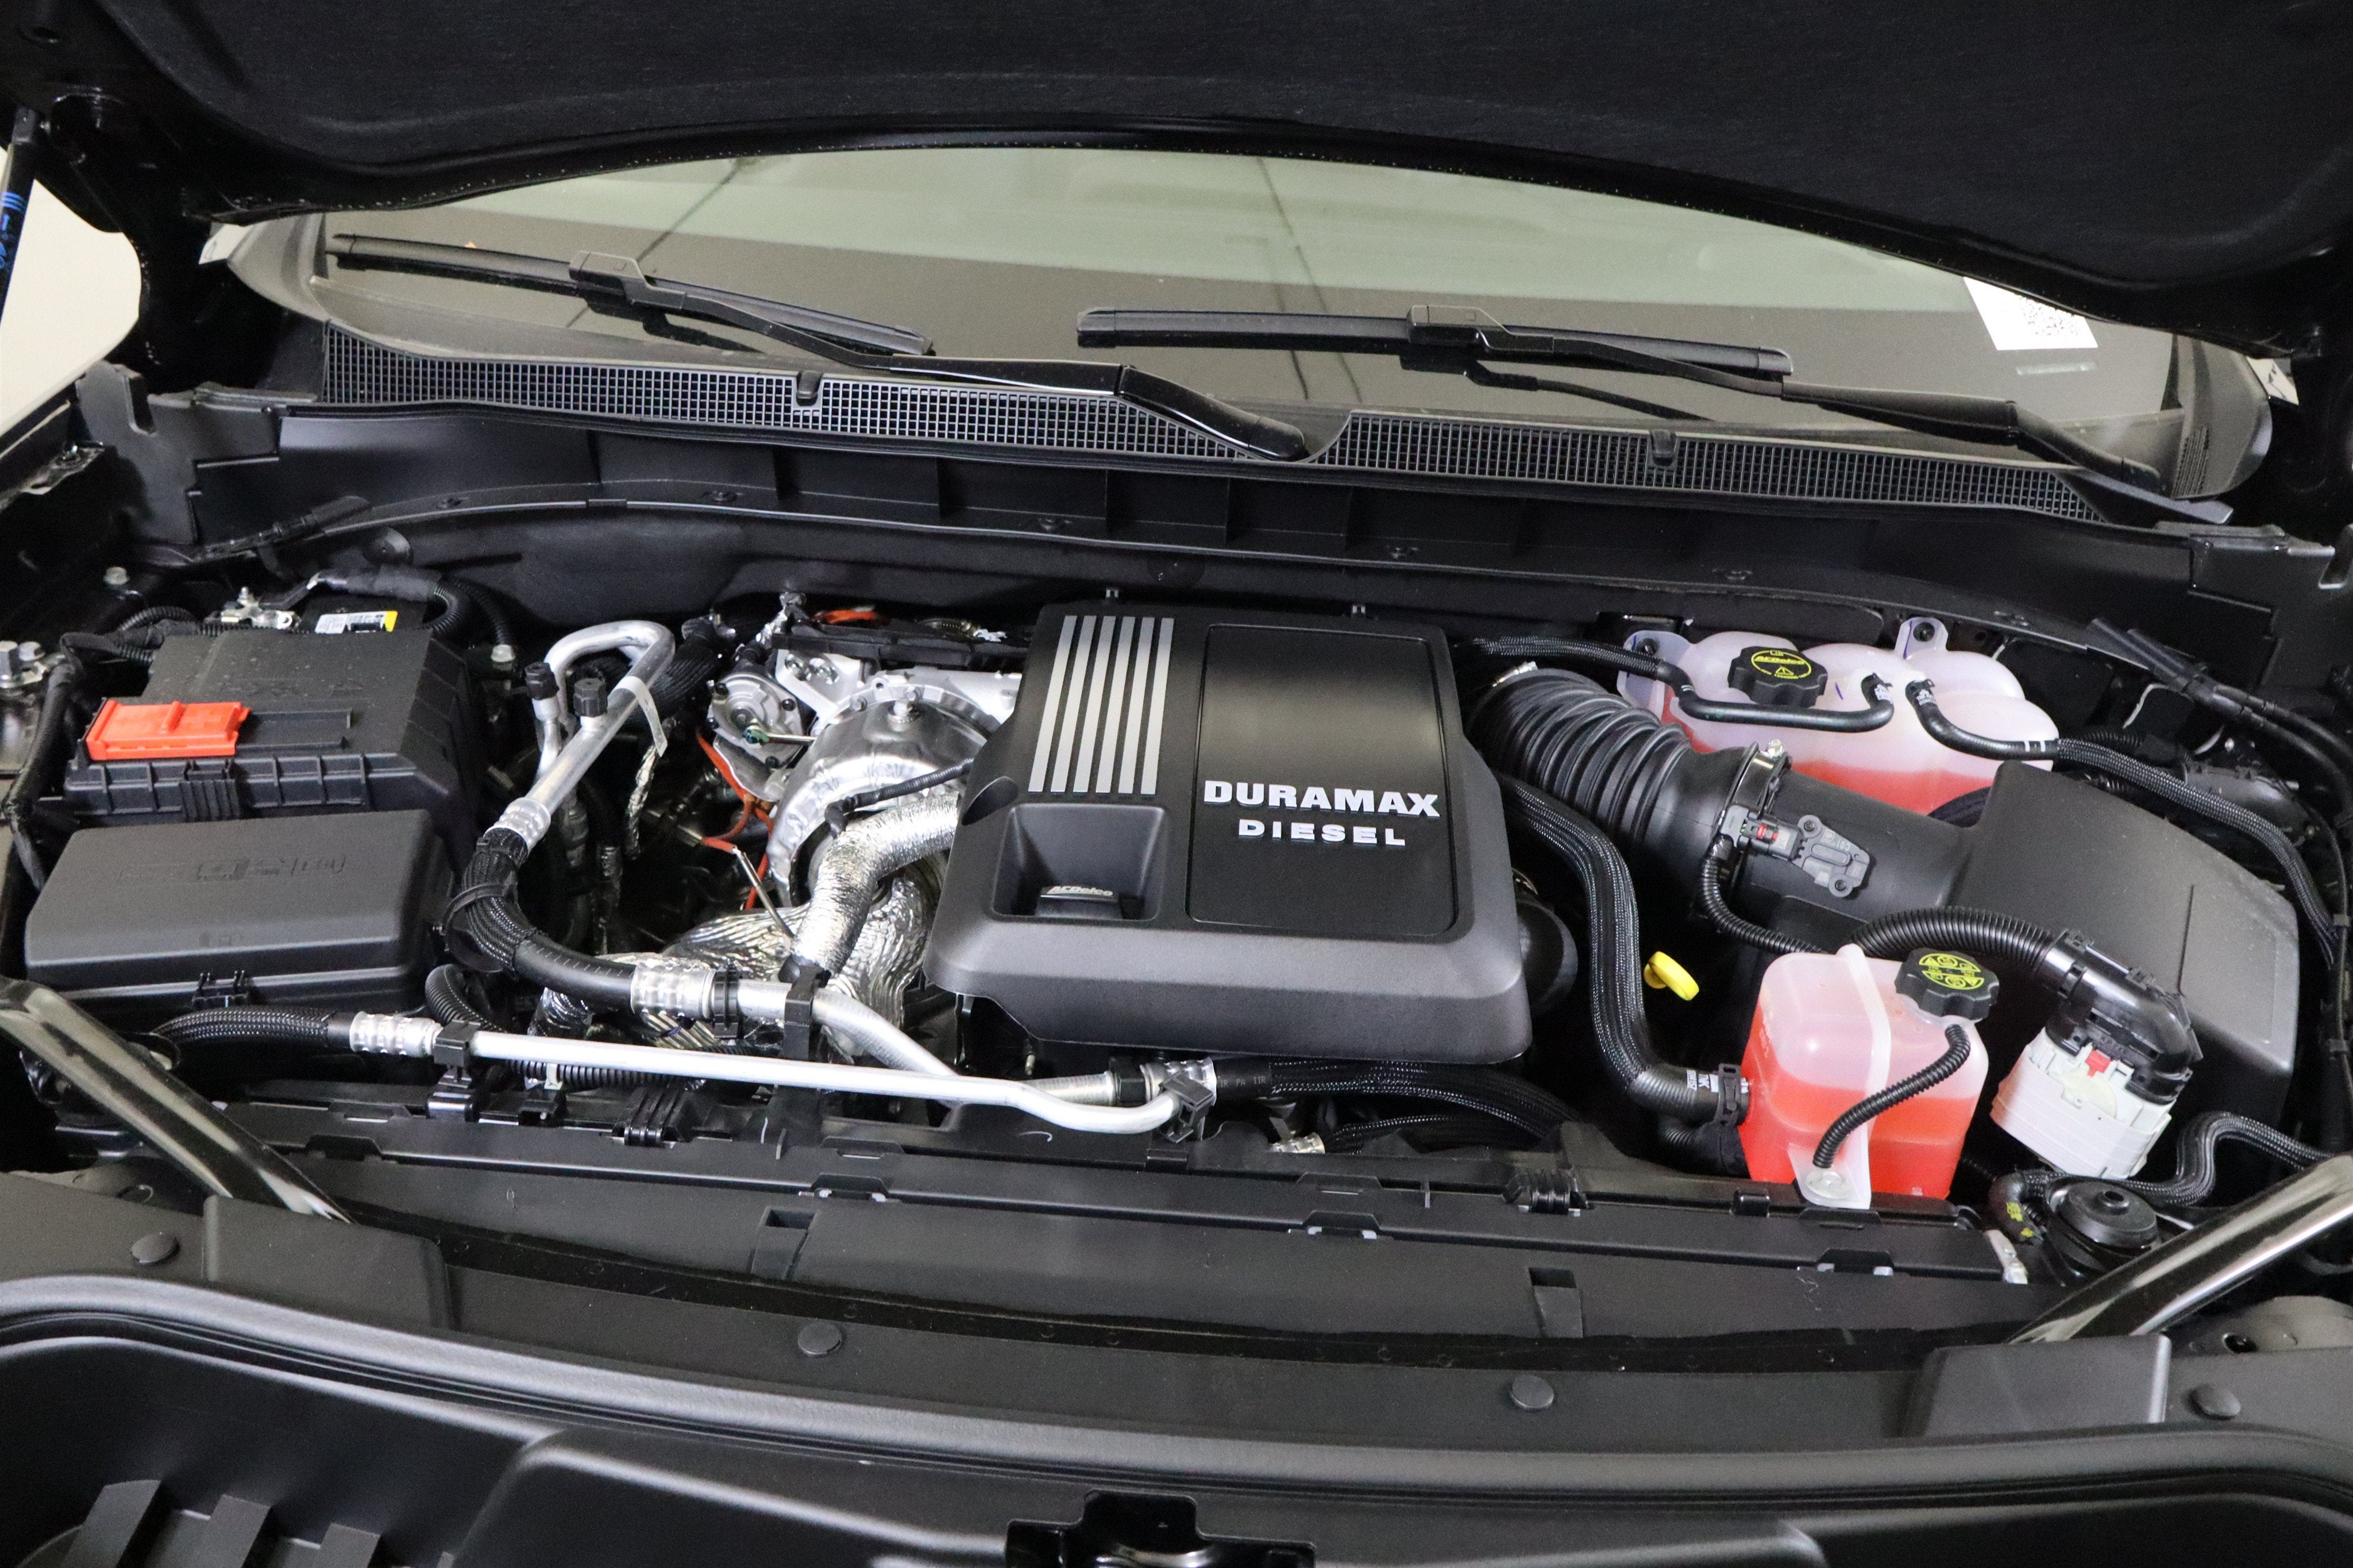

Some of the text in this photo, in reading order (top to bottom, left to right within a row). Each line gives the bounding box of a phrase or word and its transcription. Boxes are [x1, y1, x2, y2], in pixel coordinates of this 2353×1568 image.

[1204, 780, 1440, 818] DURAMAX
[1238, 818, 1406, 847] DIESEL
[1047, 886, 1113, 896] ACDelco
